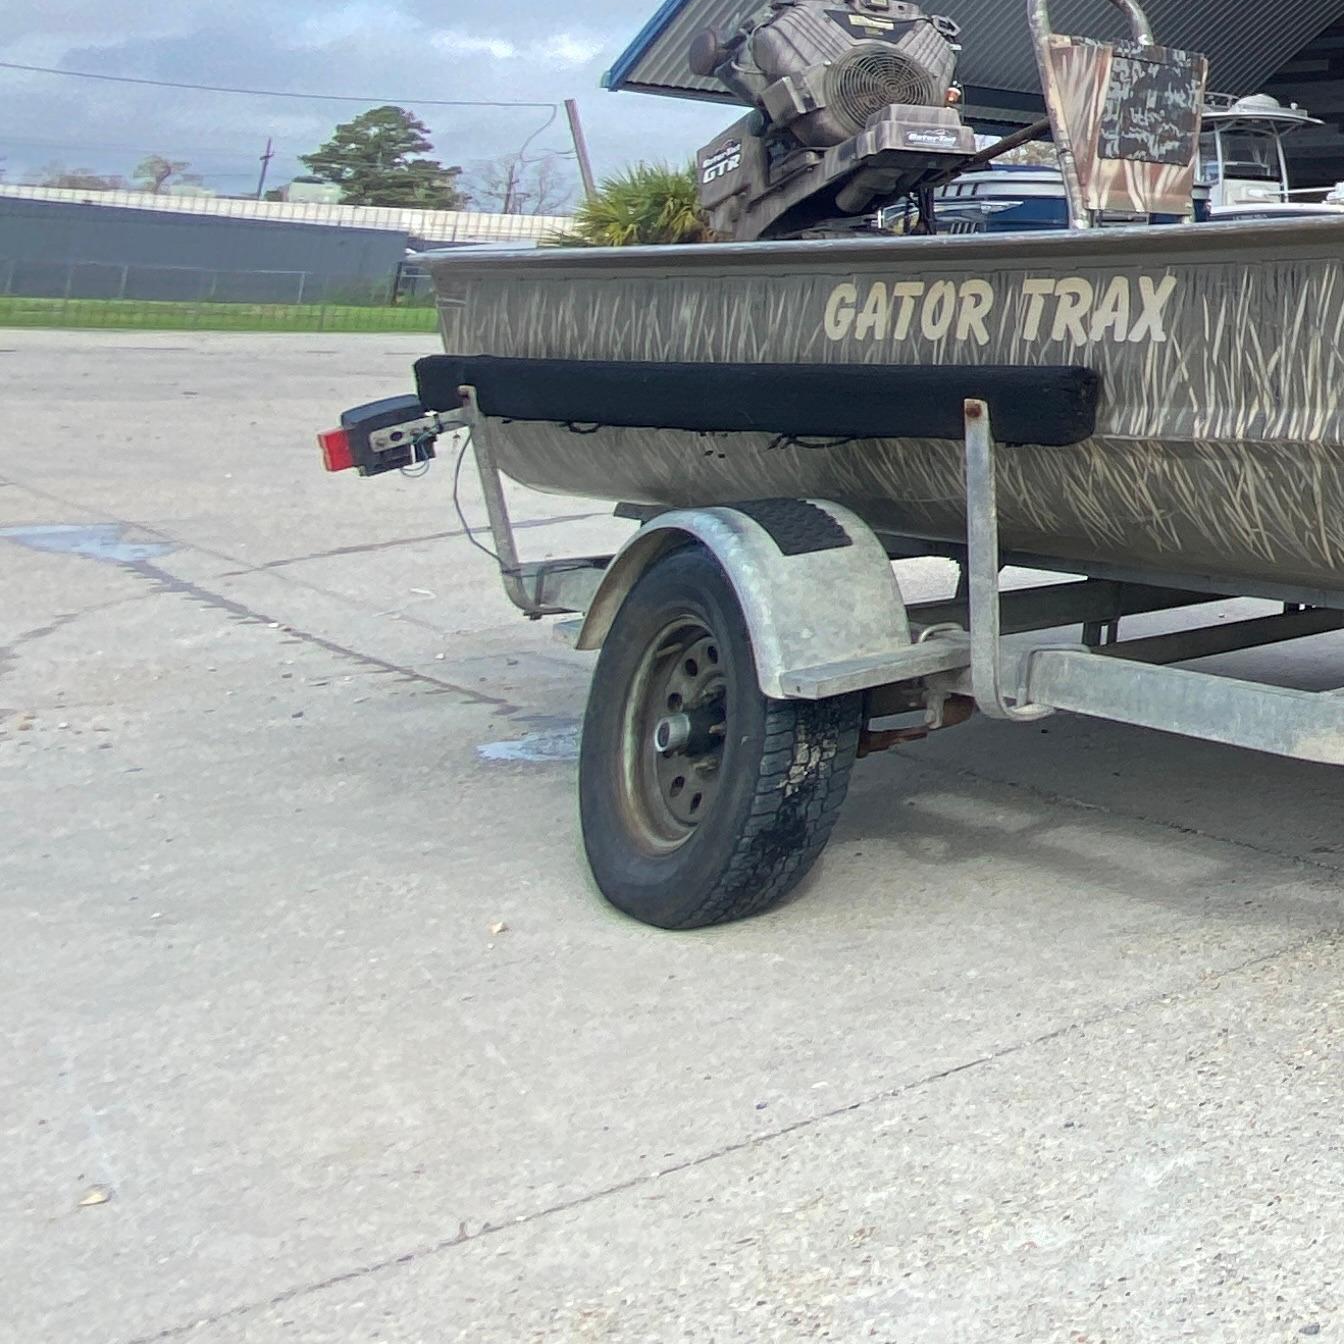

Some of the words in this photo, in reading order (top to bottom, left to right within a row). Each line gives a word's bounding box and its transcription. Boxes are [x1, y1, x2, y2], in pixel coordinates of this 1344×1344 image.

[703, 154, 741, 184] GTR
[824, 278, 994, 347] GATOR
[1021, 275, 1177, 347] TRAX
